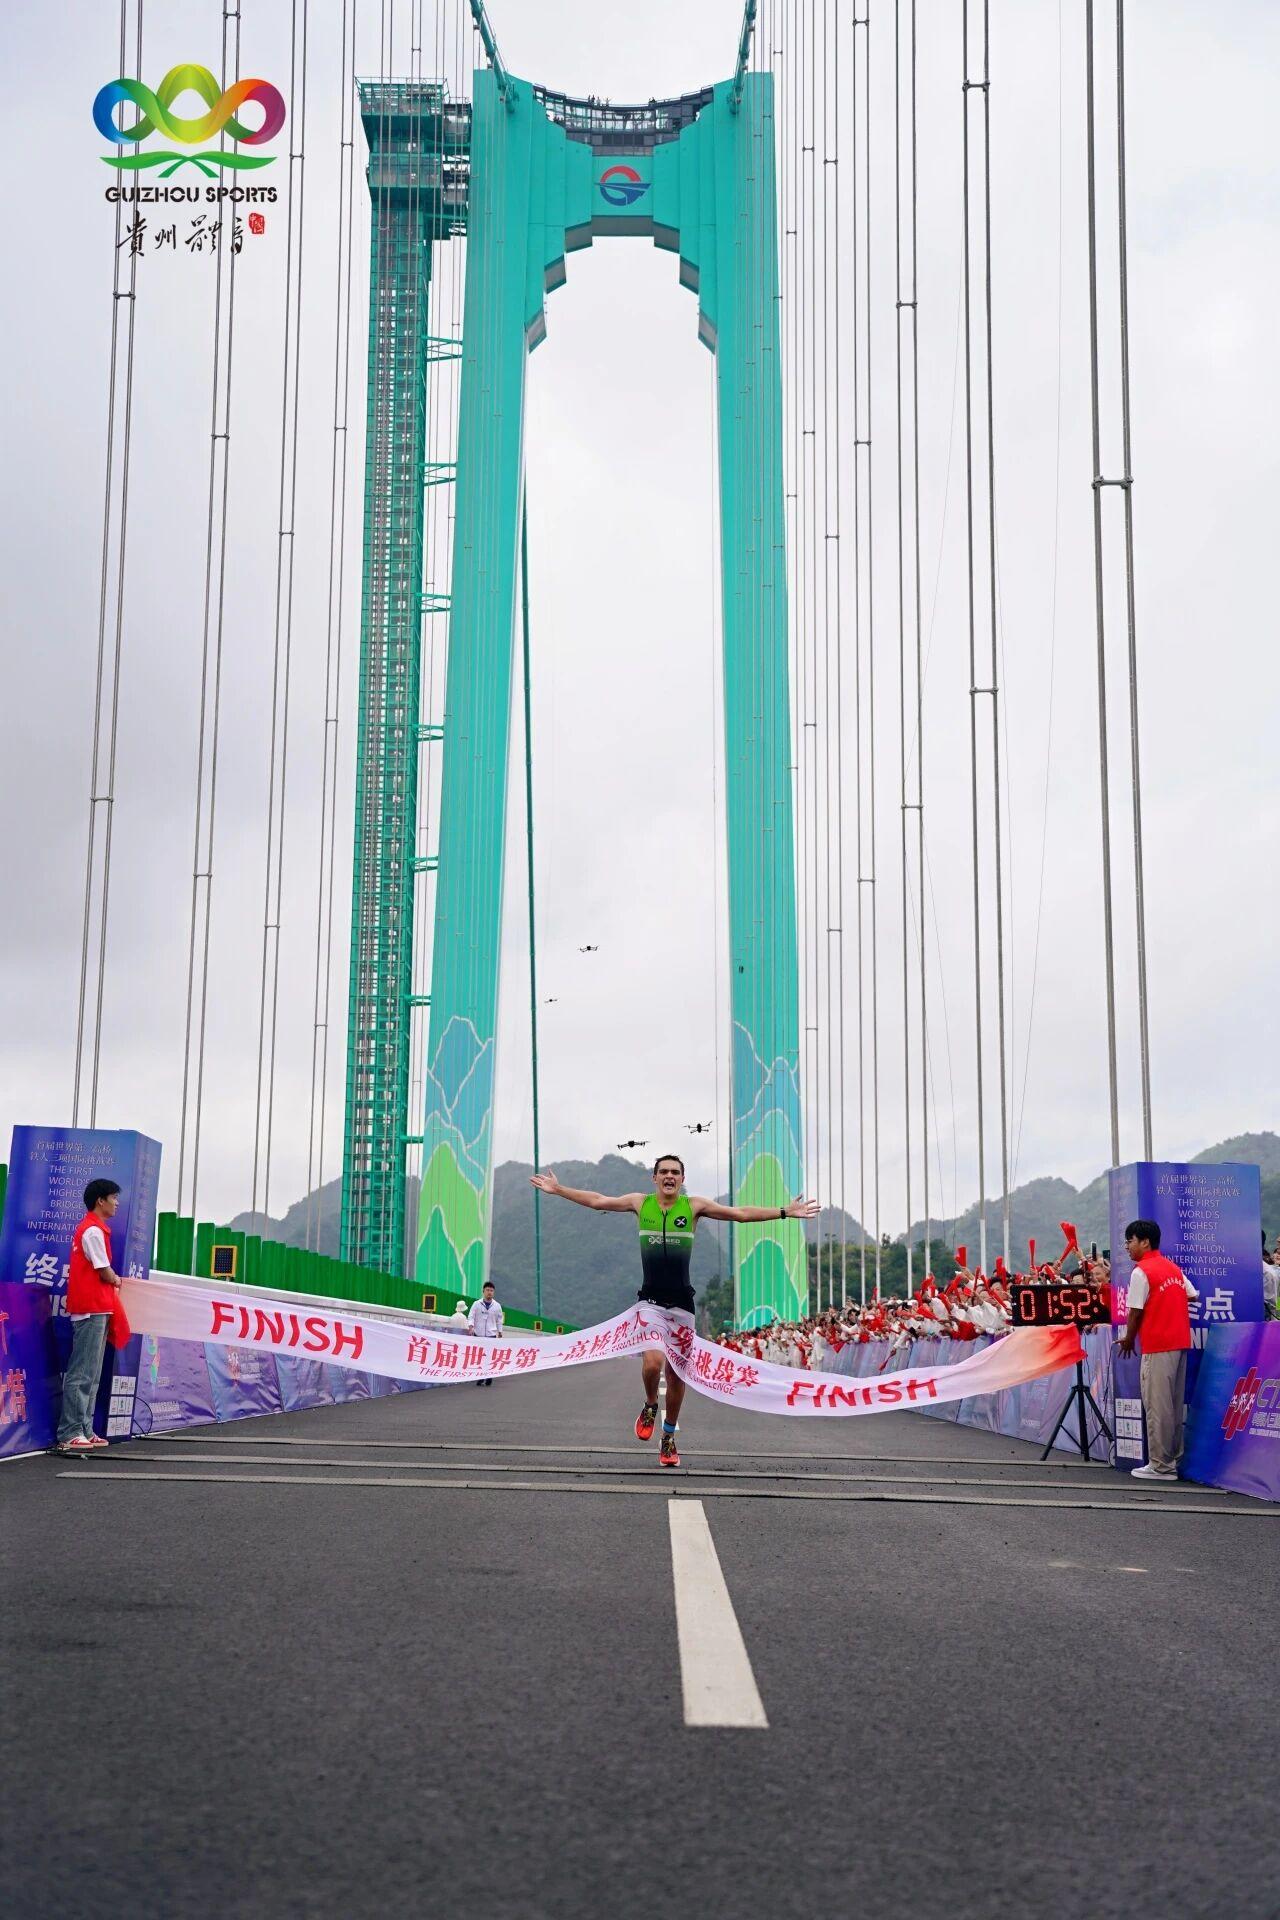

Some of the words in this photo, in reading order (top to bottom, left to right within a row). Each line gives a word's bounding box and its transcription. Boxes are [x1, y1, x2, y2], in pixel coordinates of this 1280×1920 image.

[50, 1165, 67, 1174] THE
[69, 1167, 93, 1176] FIRST
[48, 1188, 84, 1198] HIGHES
[50, 1199, 84, 1210] BRIDGE
[1177, 1198, 1194, 1208] THE
[1196, 1199, 1221, 1208] FIRST
[1180, 1221, 1219, 1231] HIGHEST
[1183, 1232, 1217, 1242] BRIDGE
[1175, 1243, 1226, 1254] TRIATHLON
[1181, 1267, 1229, 1277] HALLENGE
[210, 1300, 364, 1360] FINISH
[419, 1366, 440, 1378] THE
[442, 1369, 475, 1379] FIRST
[785, 1378, 938, 1408] FINISH
